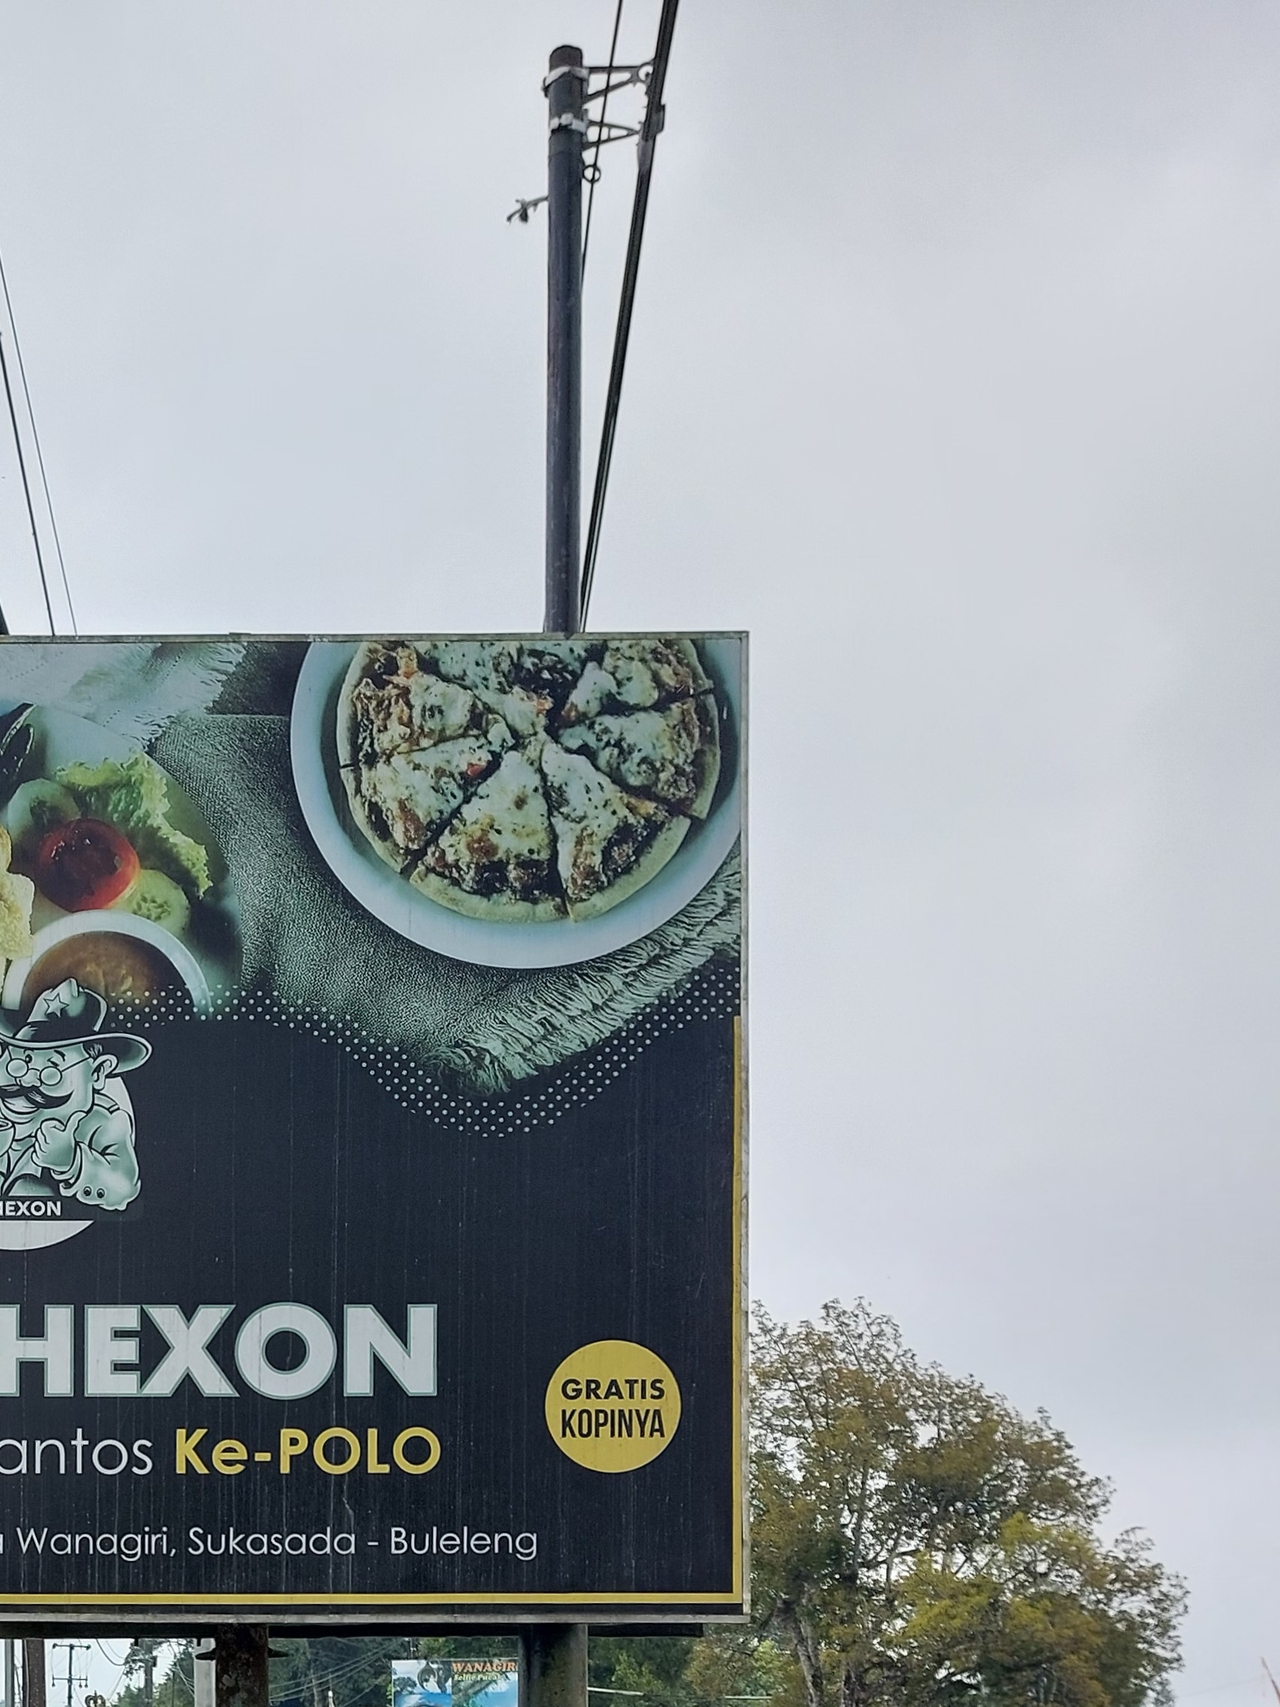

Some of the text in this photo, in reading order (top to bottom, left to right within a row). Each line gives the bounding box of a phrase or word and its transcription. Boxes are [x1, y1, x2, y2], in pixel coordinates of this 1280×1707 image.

[561, 1378, 666, 1401] GRATIS
[560, 1408, 666, 1440] KOPINYA
[175, 1427, 441, 1475] Ke-POLO
[16, 1526, 176, 1562] Wanagiri,
[187, 1526, 356, 1556] Sukasada
[390, 1525, 537, 1561] Buleleng
[452, 1661, 519, 1672] WANAGIR
